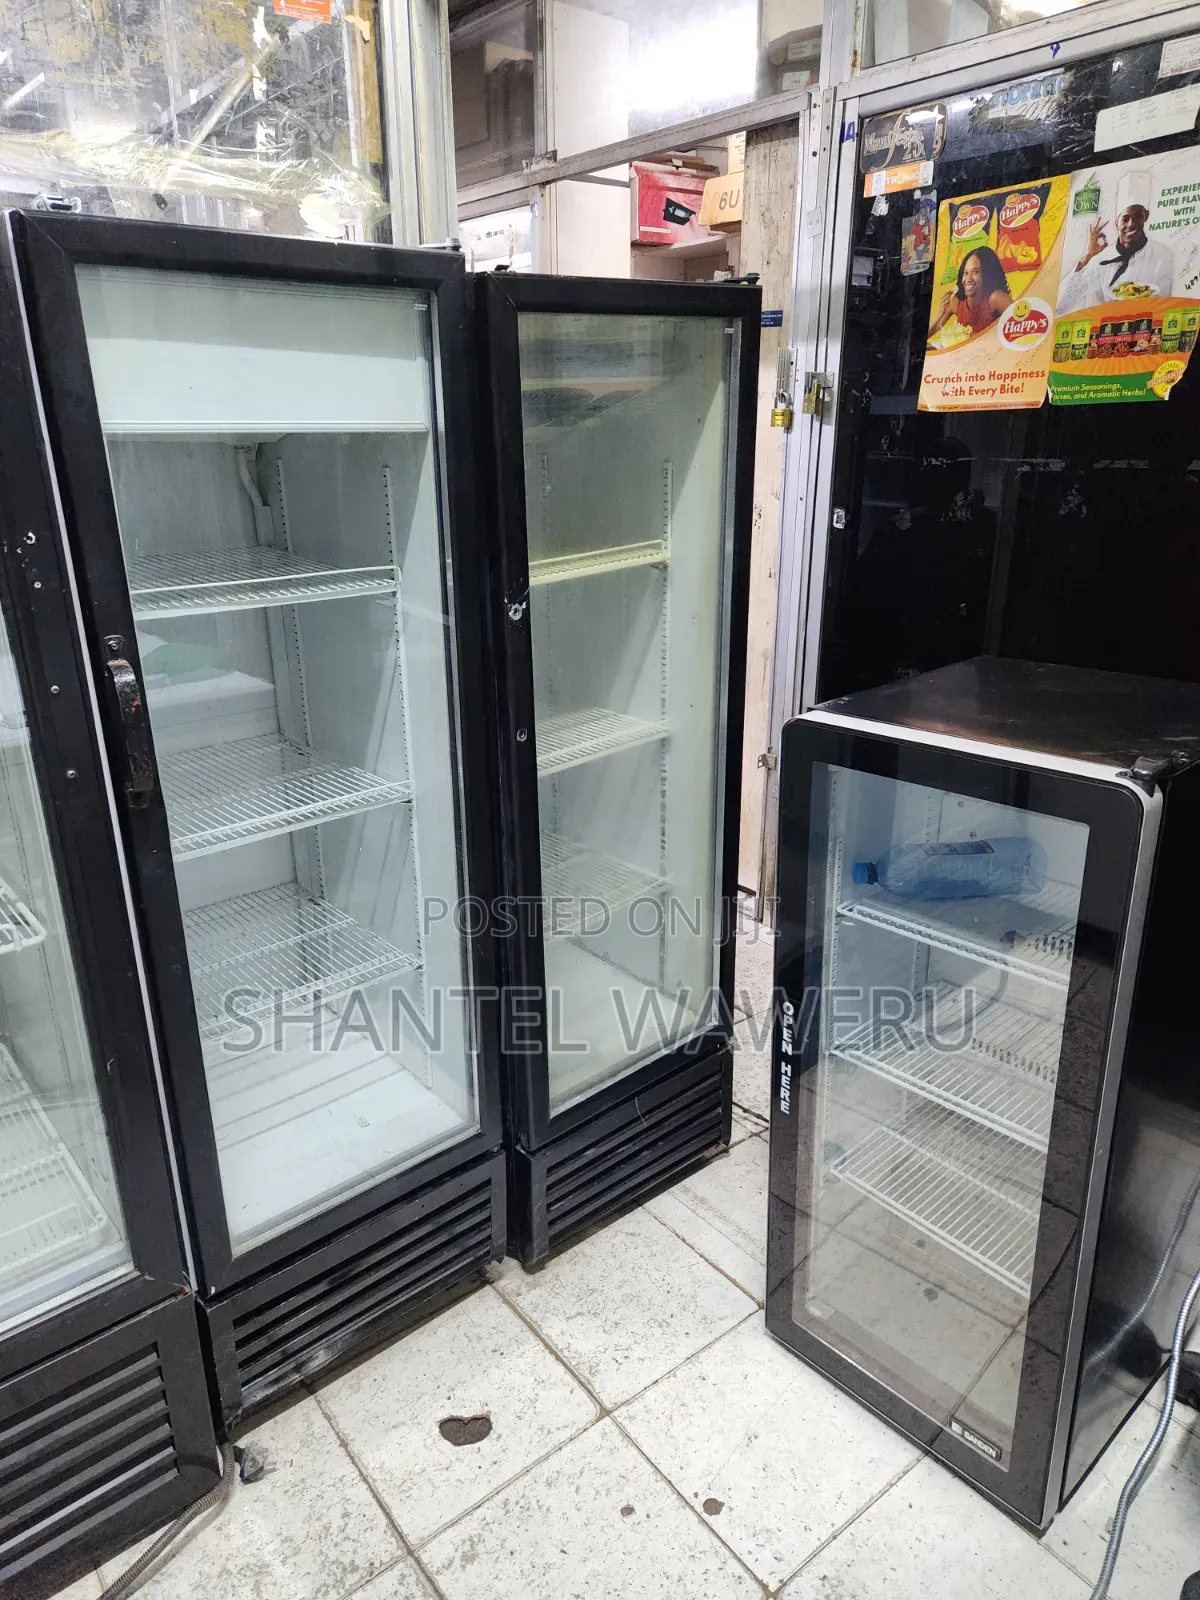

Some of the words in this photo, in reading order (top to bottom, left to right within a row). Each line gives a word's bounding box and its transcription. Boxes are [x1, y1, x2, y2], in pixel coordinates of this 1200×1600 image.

[718, 189, 740, 211] 6U
[1074, 201, 1099, 212] OWN
[1157, 197, 1180, 208] PURE
[1173, 206, 1196, 217] WITH
[1149, 217, 1191, 231] NATURE'S
[1191, 215, 1200, 225] O
[923, 372, 963, 385] Crunch
[964, 372, 986, 383] into
[988, 368, 1046, 384] Happiness
[1157, 362, 1181, 376] AROMA
[1149, 369, 1185, 387] GUARANT
[968, 385, 998, 398] Every
[999, 382, 1025, 395] Bite!
[1050, 384, 1080, 392] Premium
[1081, 382, 1122, 391] Seasonings,
[1051, 392, 1073, 401] pices,
[1074, 391, 1087, 399] and
[1088, 389, 1121, 399] Aromatic
[1121, 387, 1147, 396] Herbs!
[781, 1001, 795, 1056] OPEN
[780, 1061, 792, 1115] HERE
[963, 1430, 997, 1458] SANDEN
